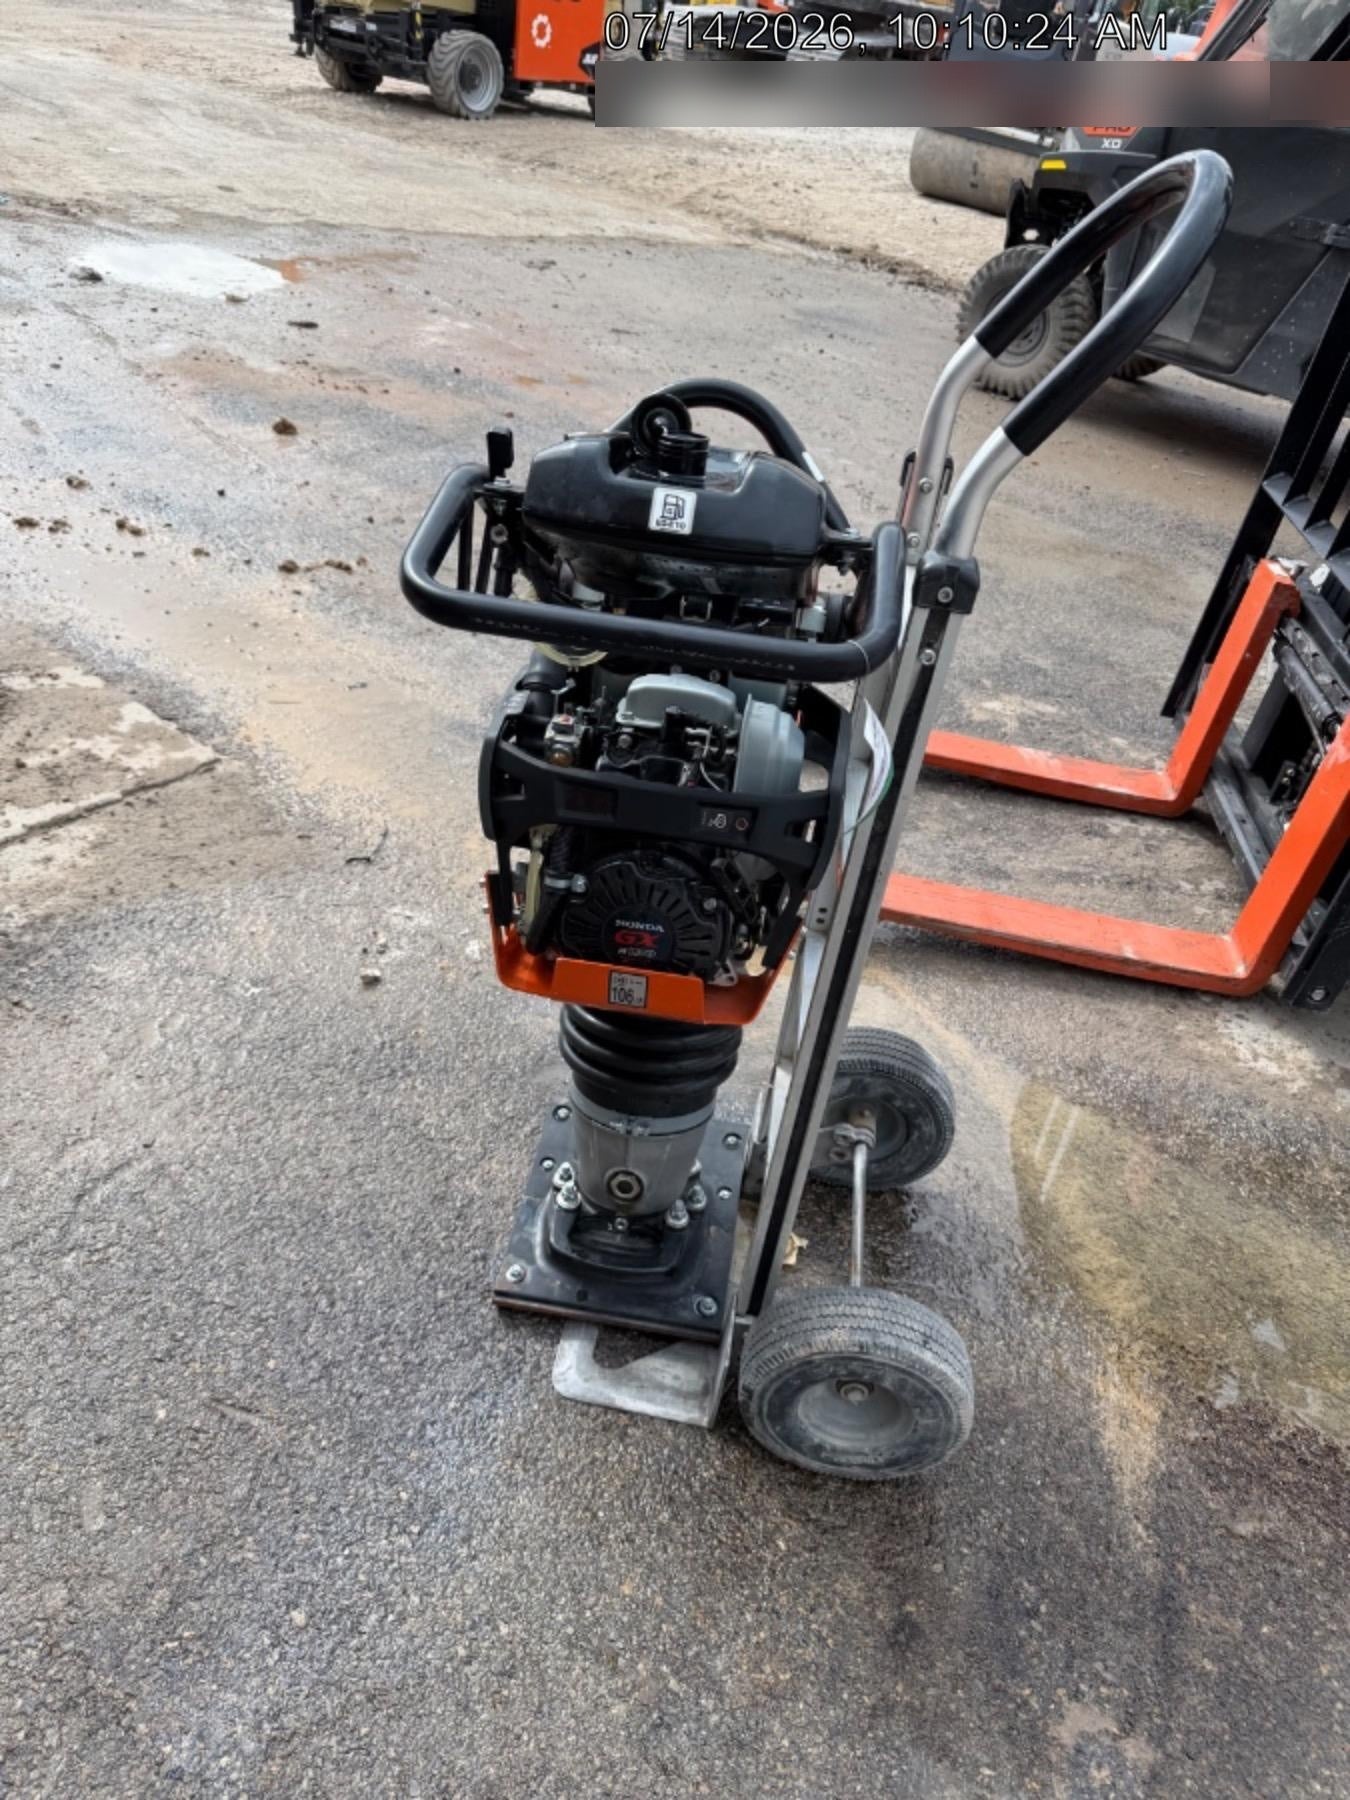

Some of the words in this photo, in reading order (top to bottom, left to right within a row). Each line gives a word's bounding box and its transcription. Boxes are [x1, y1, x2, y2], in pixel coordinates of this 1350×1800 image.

[1101, 137, 1122, 149] XD
[615, 919, 665, 933] HONDA
[614, 930, 659, 948] GX
[613, 987, 635, 1004] 106
